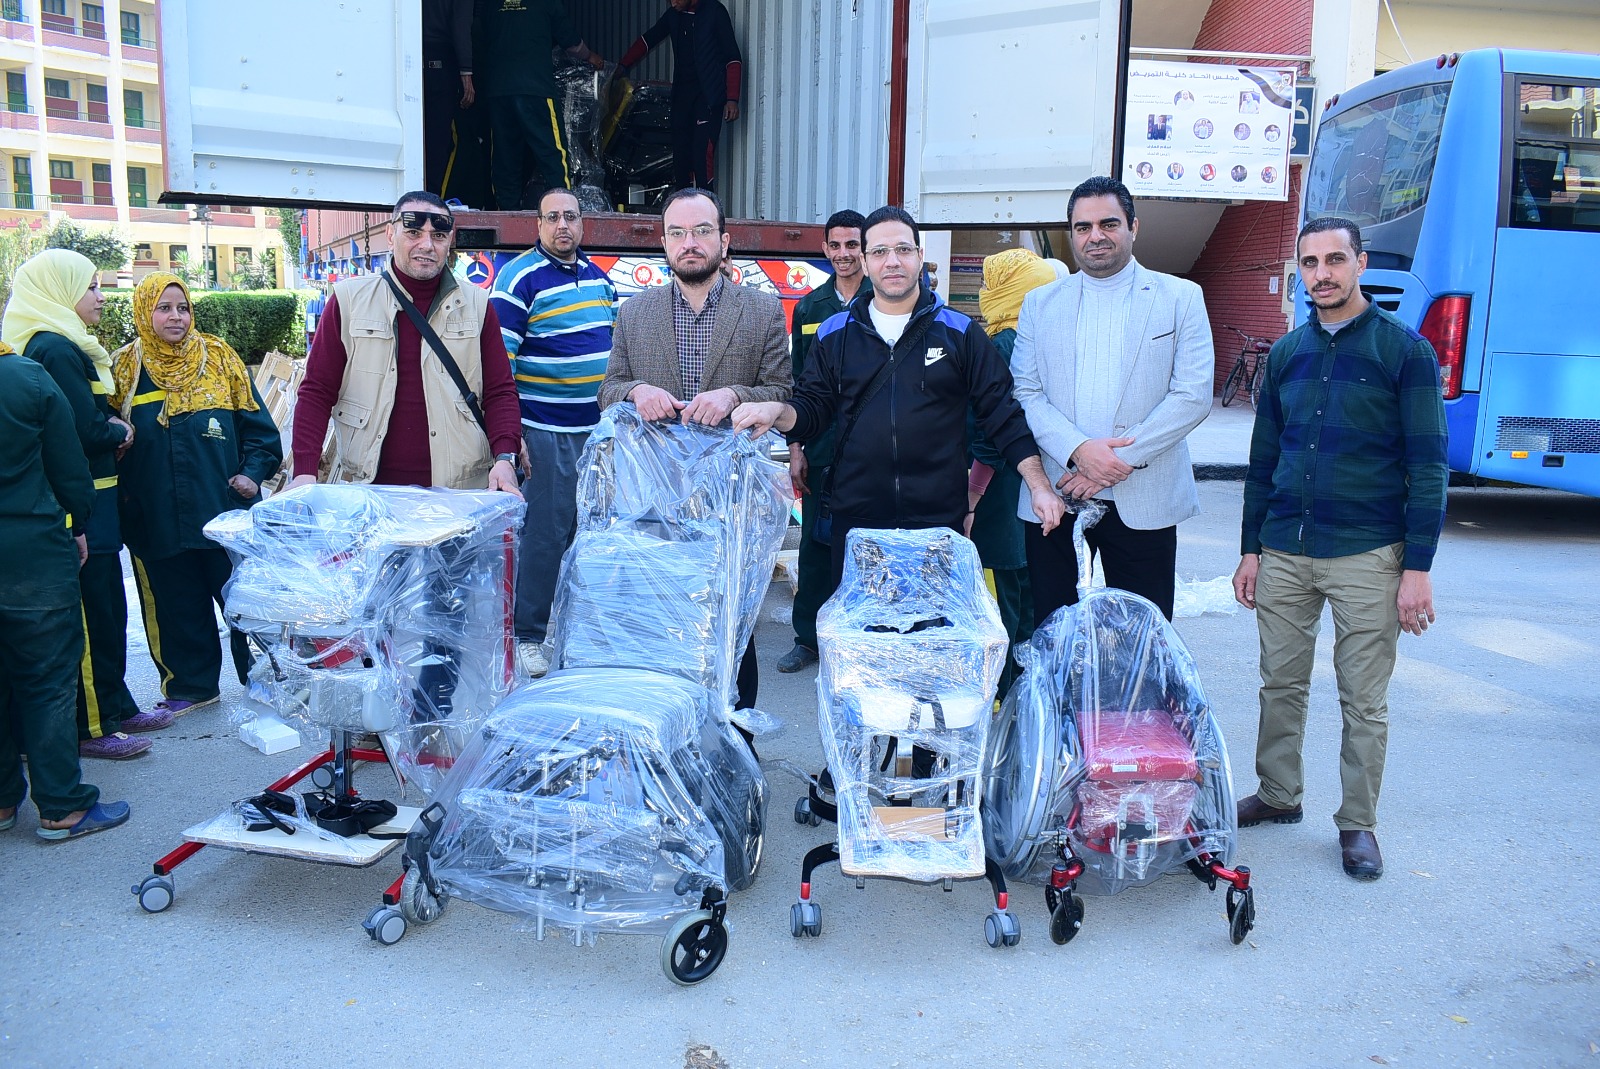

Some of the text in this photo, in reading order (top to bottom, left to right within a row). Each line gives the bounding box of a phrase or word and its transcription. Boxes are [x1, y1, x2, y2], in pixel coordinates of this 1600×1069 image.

[1129, 70, 1164, 79] التمريض
[1164, 70, 1187, 79] كلية
[1212, 73, 1240, 81] مجلس
[927, 347, 944, 358] NIKE
